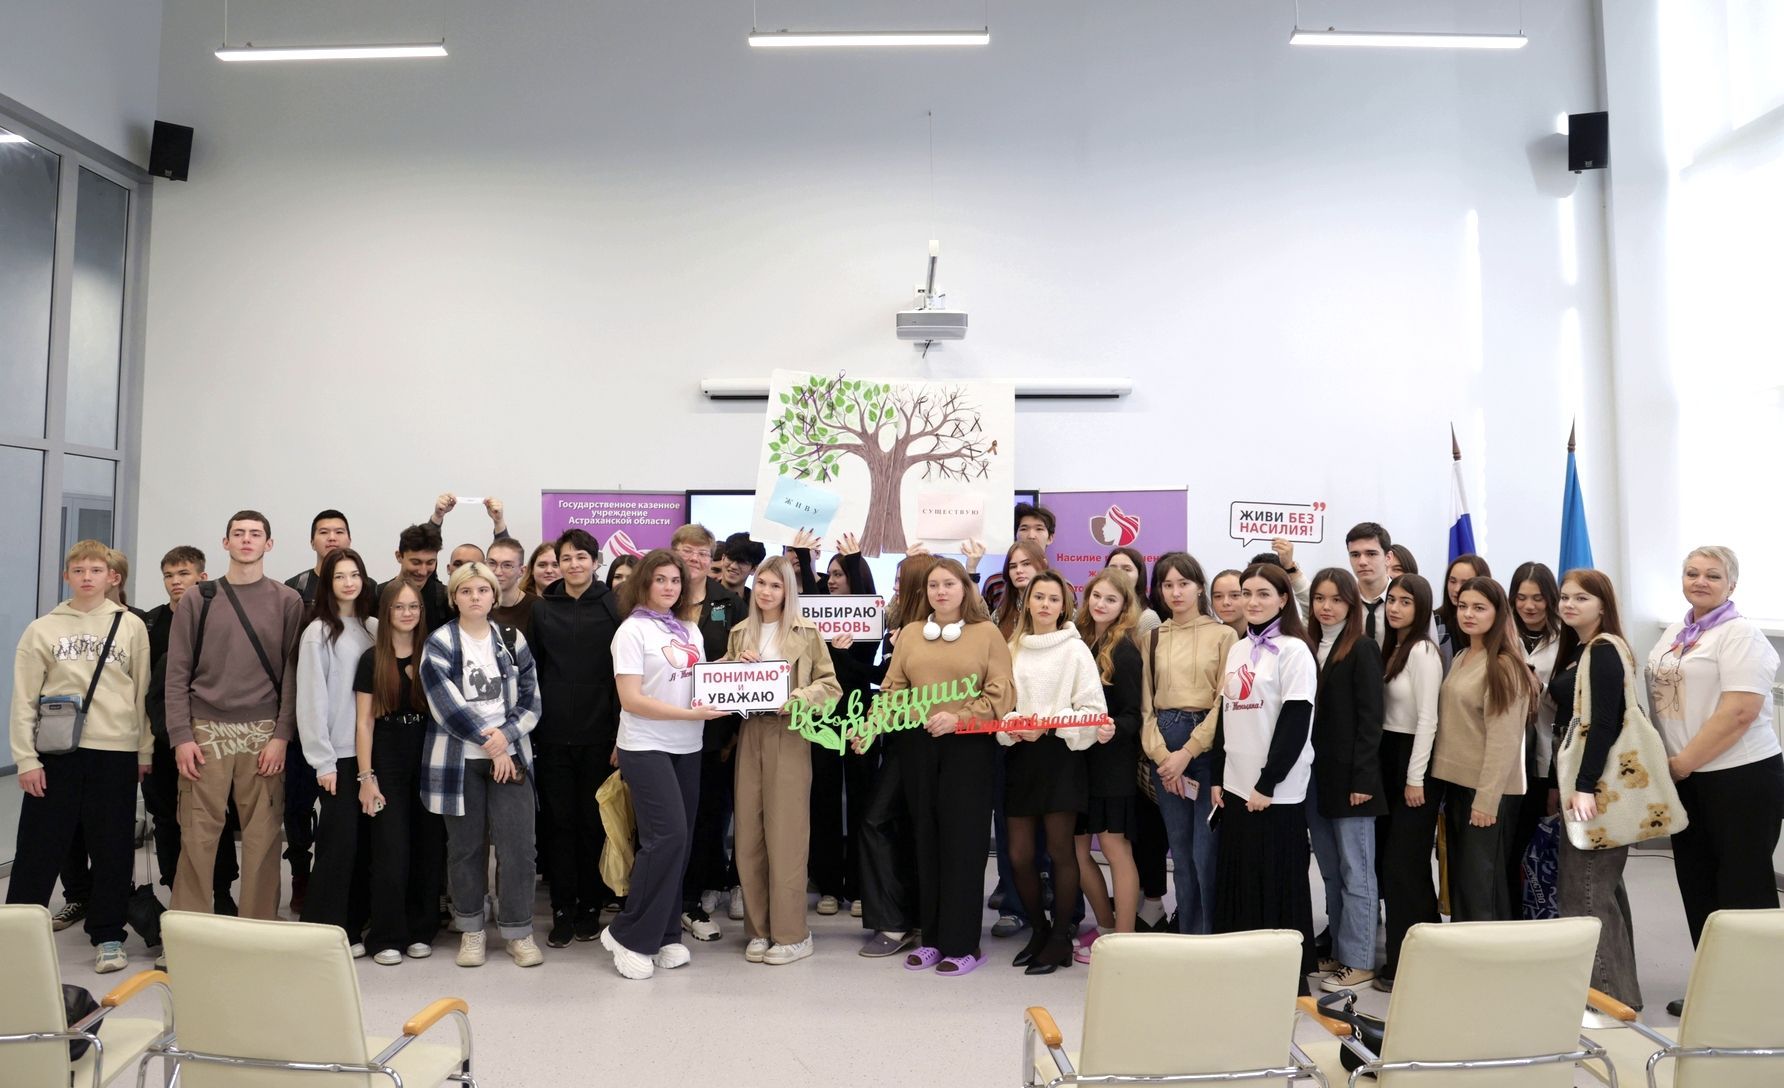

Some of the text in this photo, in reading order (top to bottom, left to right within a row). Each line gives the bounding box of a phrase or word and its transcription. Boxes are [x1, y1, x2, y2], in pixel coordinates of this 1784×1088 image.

[558, 500, 680, 510] Государственное казенное
[784, 497, 820, 515] ЖИВУ
[591, 510, 648, 518] учреждение
[1240, 510, 1315, 524] ЖИВИ БЕЗ
[568, 516, 671, 526] Астраханской области
[1240, 522, 1313, 536] НАСИЛИЯ!
[1056, 553, 1102, 562] Насилие
[802, 607, 877, 619] ВЫБИРАЮ
[815, 622, 871, 633] ЮБОВЬ
[703, 670, 779, 684] ПОНИМАЮ
[708, 691, 775, 704] УВАЖАЮ
[846, 689, 863, 719] в
[872, 673, 981, 716] наших
[839, 704, 931, 756] руках
